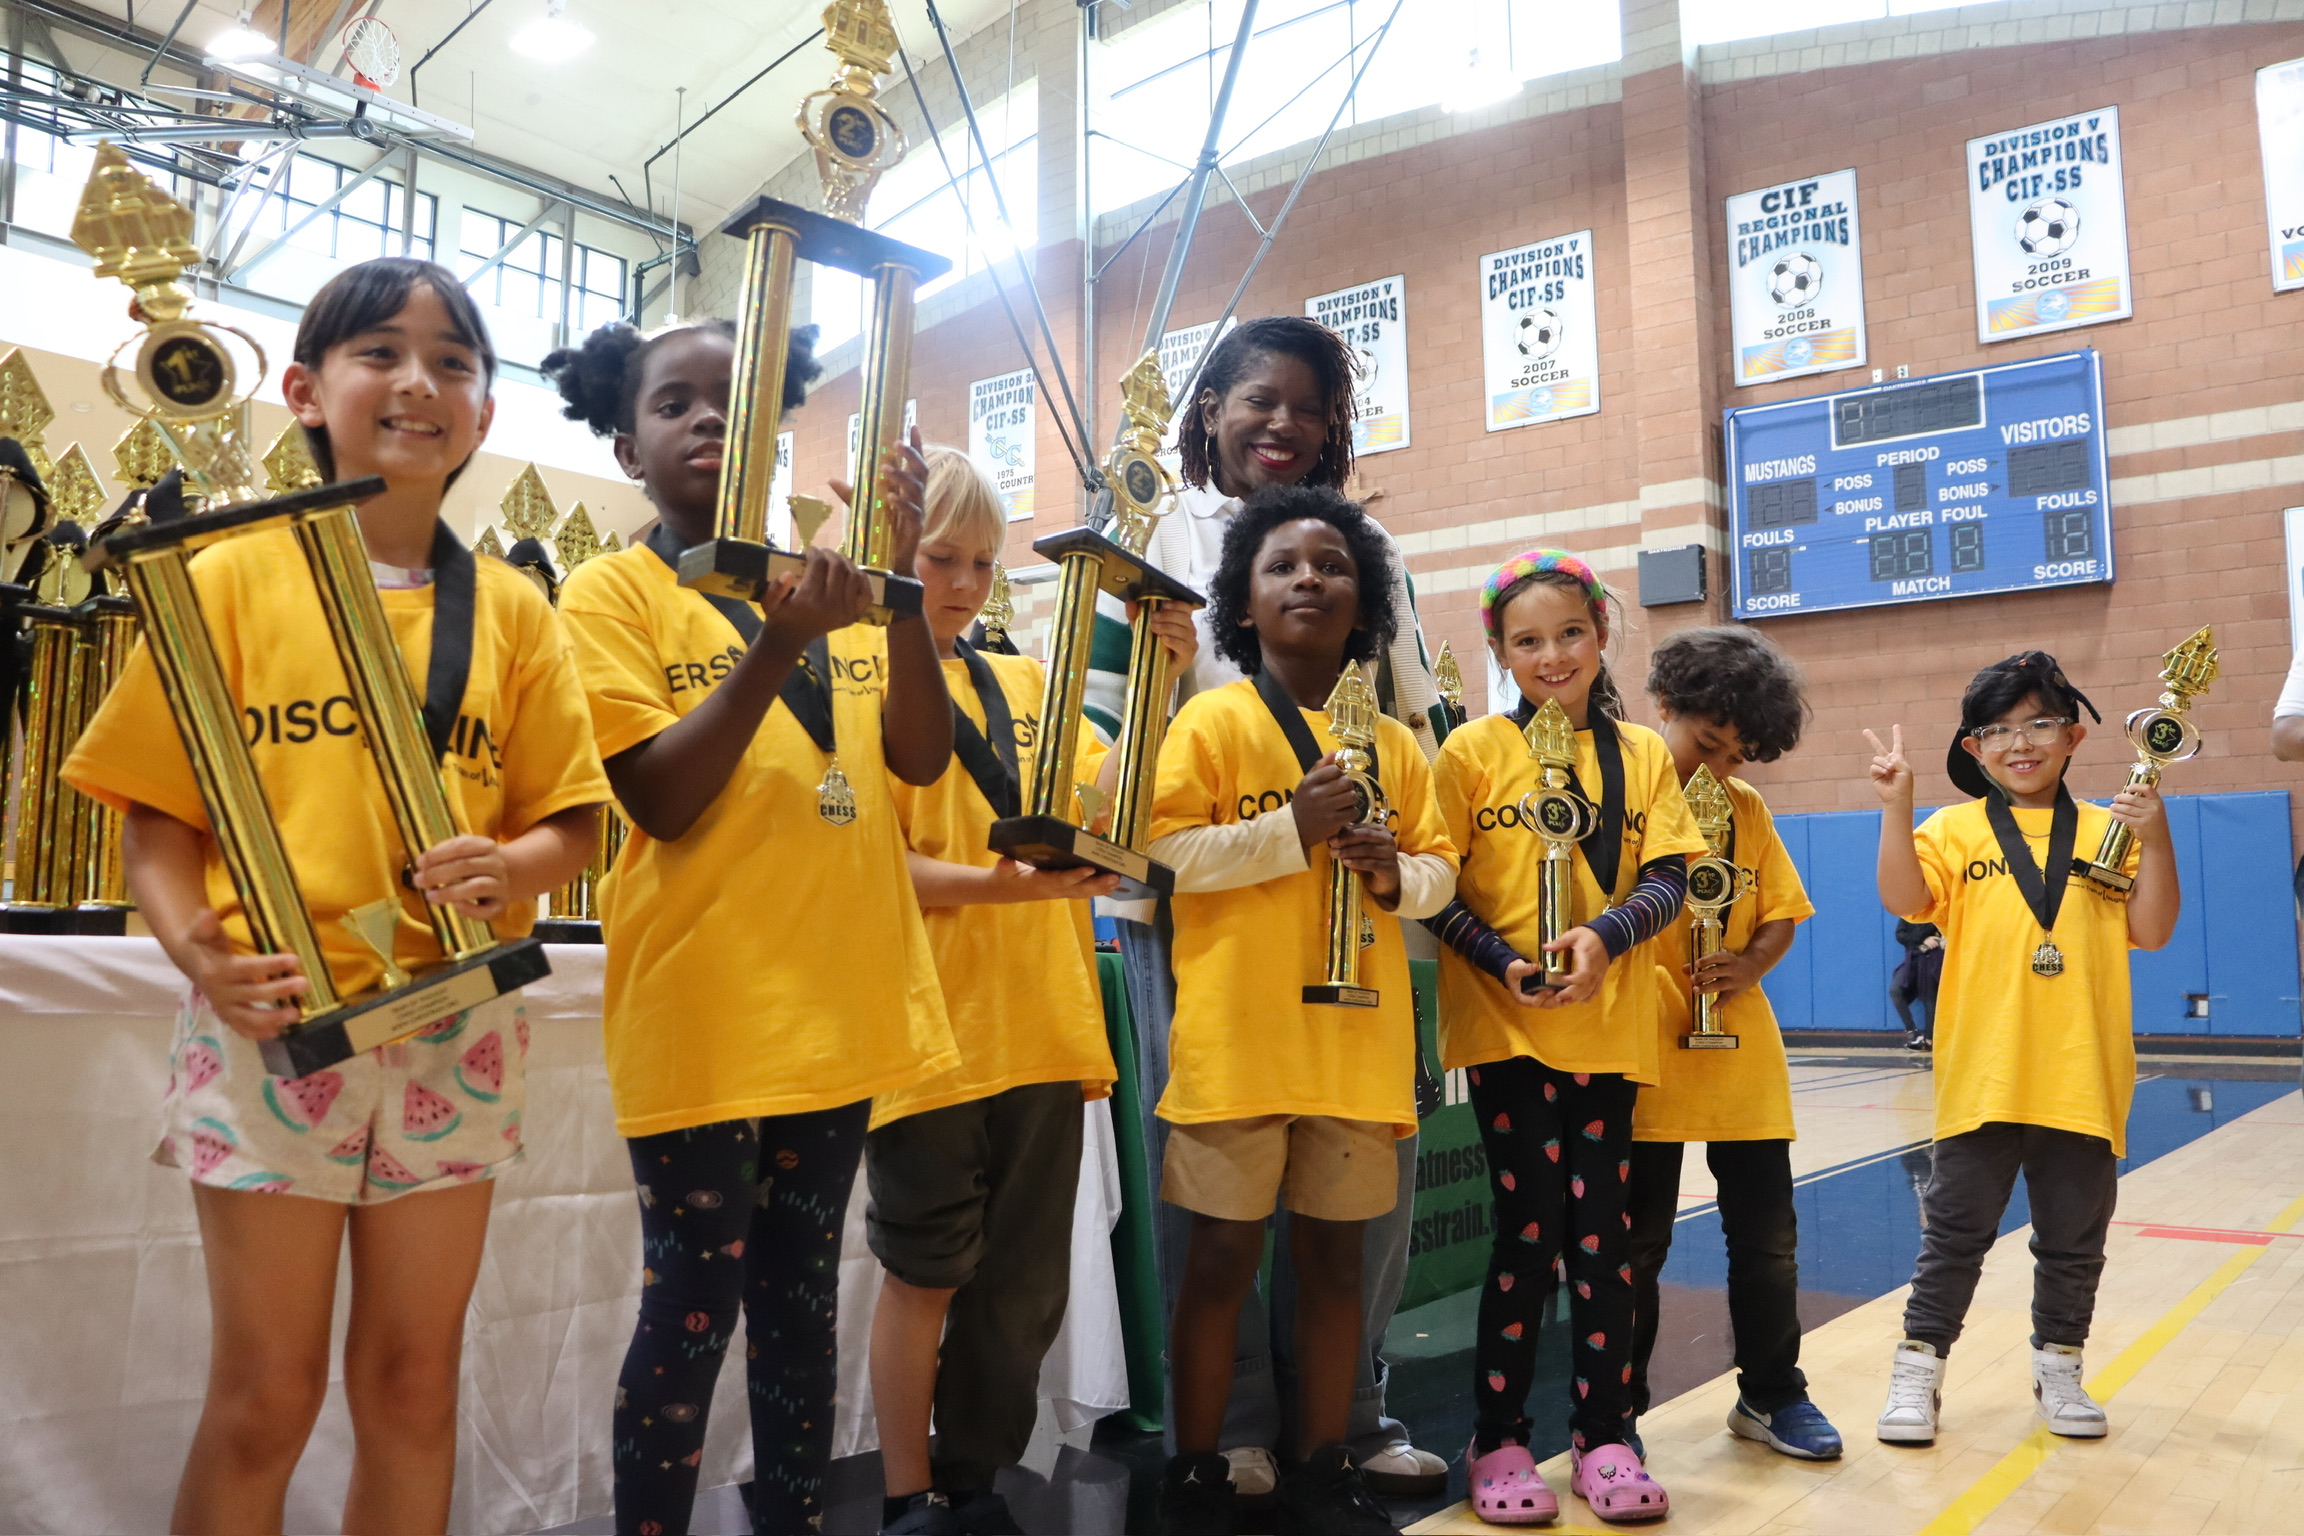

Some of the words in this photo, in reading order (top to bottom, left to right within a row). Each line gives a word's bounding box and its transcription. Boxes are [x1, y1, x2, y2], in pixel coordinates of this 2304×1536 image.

[1984, 122, 2081, 157] DIVISION
[2087, 117, 2100, 131] V
[1979, 133, 2109, 192] CHAMPIONS
[1760, 182, 1819, 214] CIF
[1737, 201, 1848, 236] REGIONAL
[1738, 217, 1849, 268] CHAMPIONS
[1494, 243, 1564, 270] DIVISION
[1570, 239, 1579, 251] V
[2028, 258, 2072, 275] 2009
[1489, 253, 1584, 301] CHAMPIONS
[2012, 269, 2090, 293] SOCCER
[1317, 286, 1380, 313] DIVISION
[1384, 283, 1392, 295] V
[1778, 308, 1815, 324] 2008
[1764, 319, 1831, 339] SOCCER
[1523, 359, 1556, 374] 2007
[975, 375, 1023, 396] DIVISION
[1511, 369, 1569, 388] SOCCER
[973, 385, 1034, 423] CHAMPION
[2001, 413, 2091, 445] VISITORS
[1877, 446, 1940, 467] PERIOD
[997, 468, 1015, 480] 1975
[1745, 454, 1816, 482] MUSTANGS
[1946, 458, 1987, 476] POSS
[1000, 475, 1034, 490] COUNTR
[1834, 474, 1872, 491] POSS
[1938, 482, 1989, 502] BONUS
[1835, 497, 1883, 515] BONUS
[2037, 490, 2097, 510] FOULS
[1865, 511, 1933, 532] PLAYER
[1942, 505, 1988, 523] FOUL
[1743, 529, 1795, 548] FOULS
[2033, 559, 2097, 580] SCORE
[1892, 576, 1950, 596] MATCH
[1746, 593, 1800, 611] SCORE
[820, 803, 857, 819] CHESS
[2032, 963, 2064, 972] CHESS
